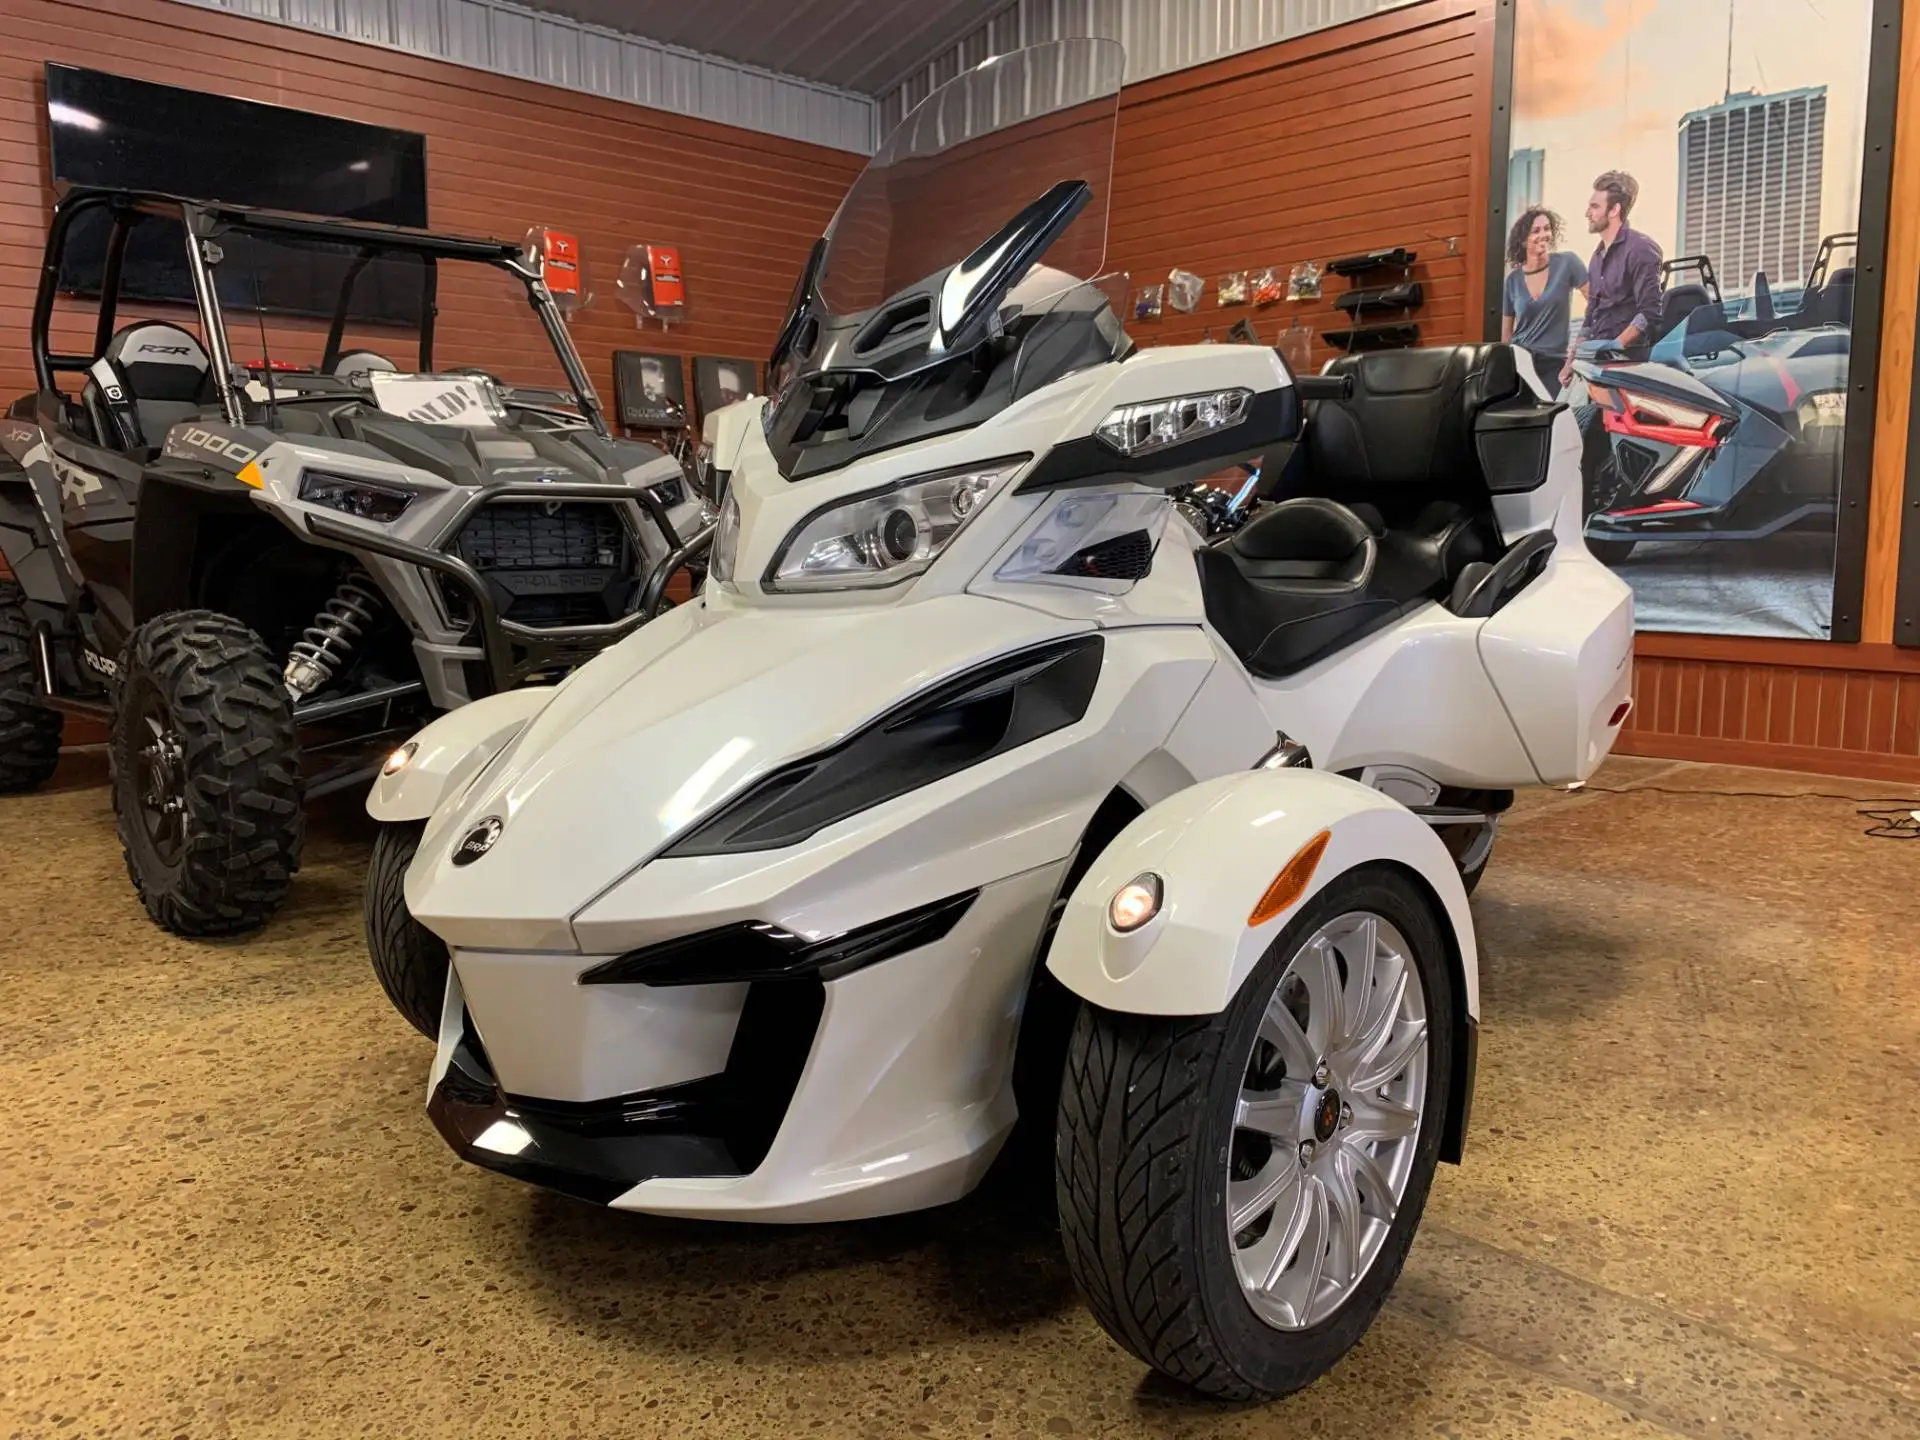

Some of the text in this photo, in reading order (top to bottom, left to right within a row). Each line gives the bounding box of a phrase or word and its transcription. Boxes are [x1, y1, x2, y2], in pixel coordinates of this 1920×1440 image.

[137, 344, 191, 356] RZR
[408, 385, 478, 423] OLD!
[6, 427, 34, 442] XP
[181, 427, 258, 464] 1000
[510, 574, 605, 589] POLARIS
[465, 841, 489, 852] BRP
